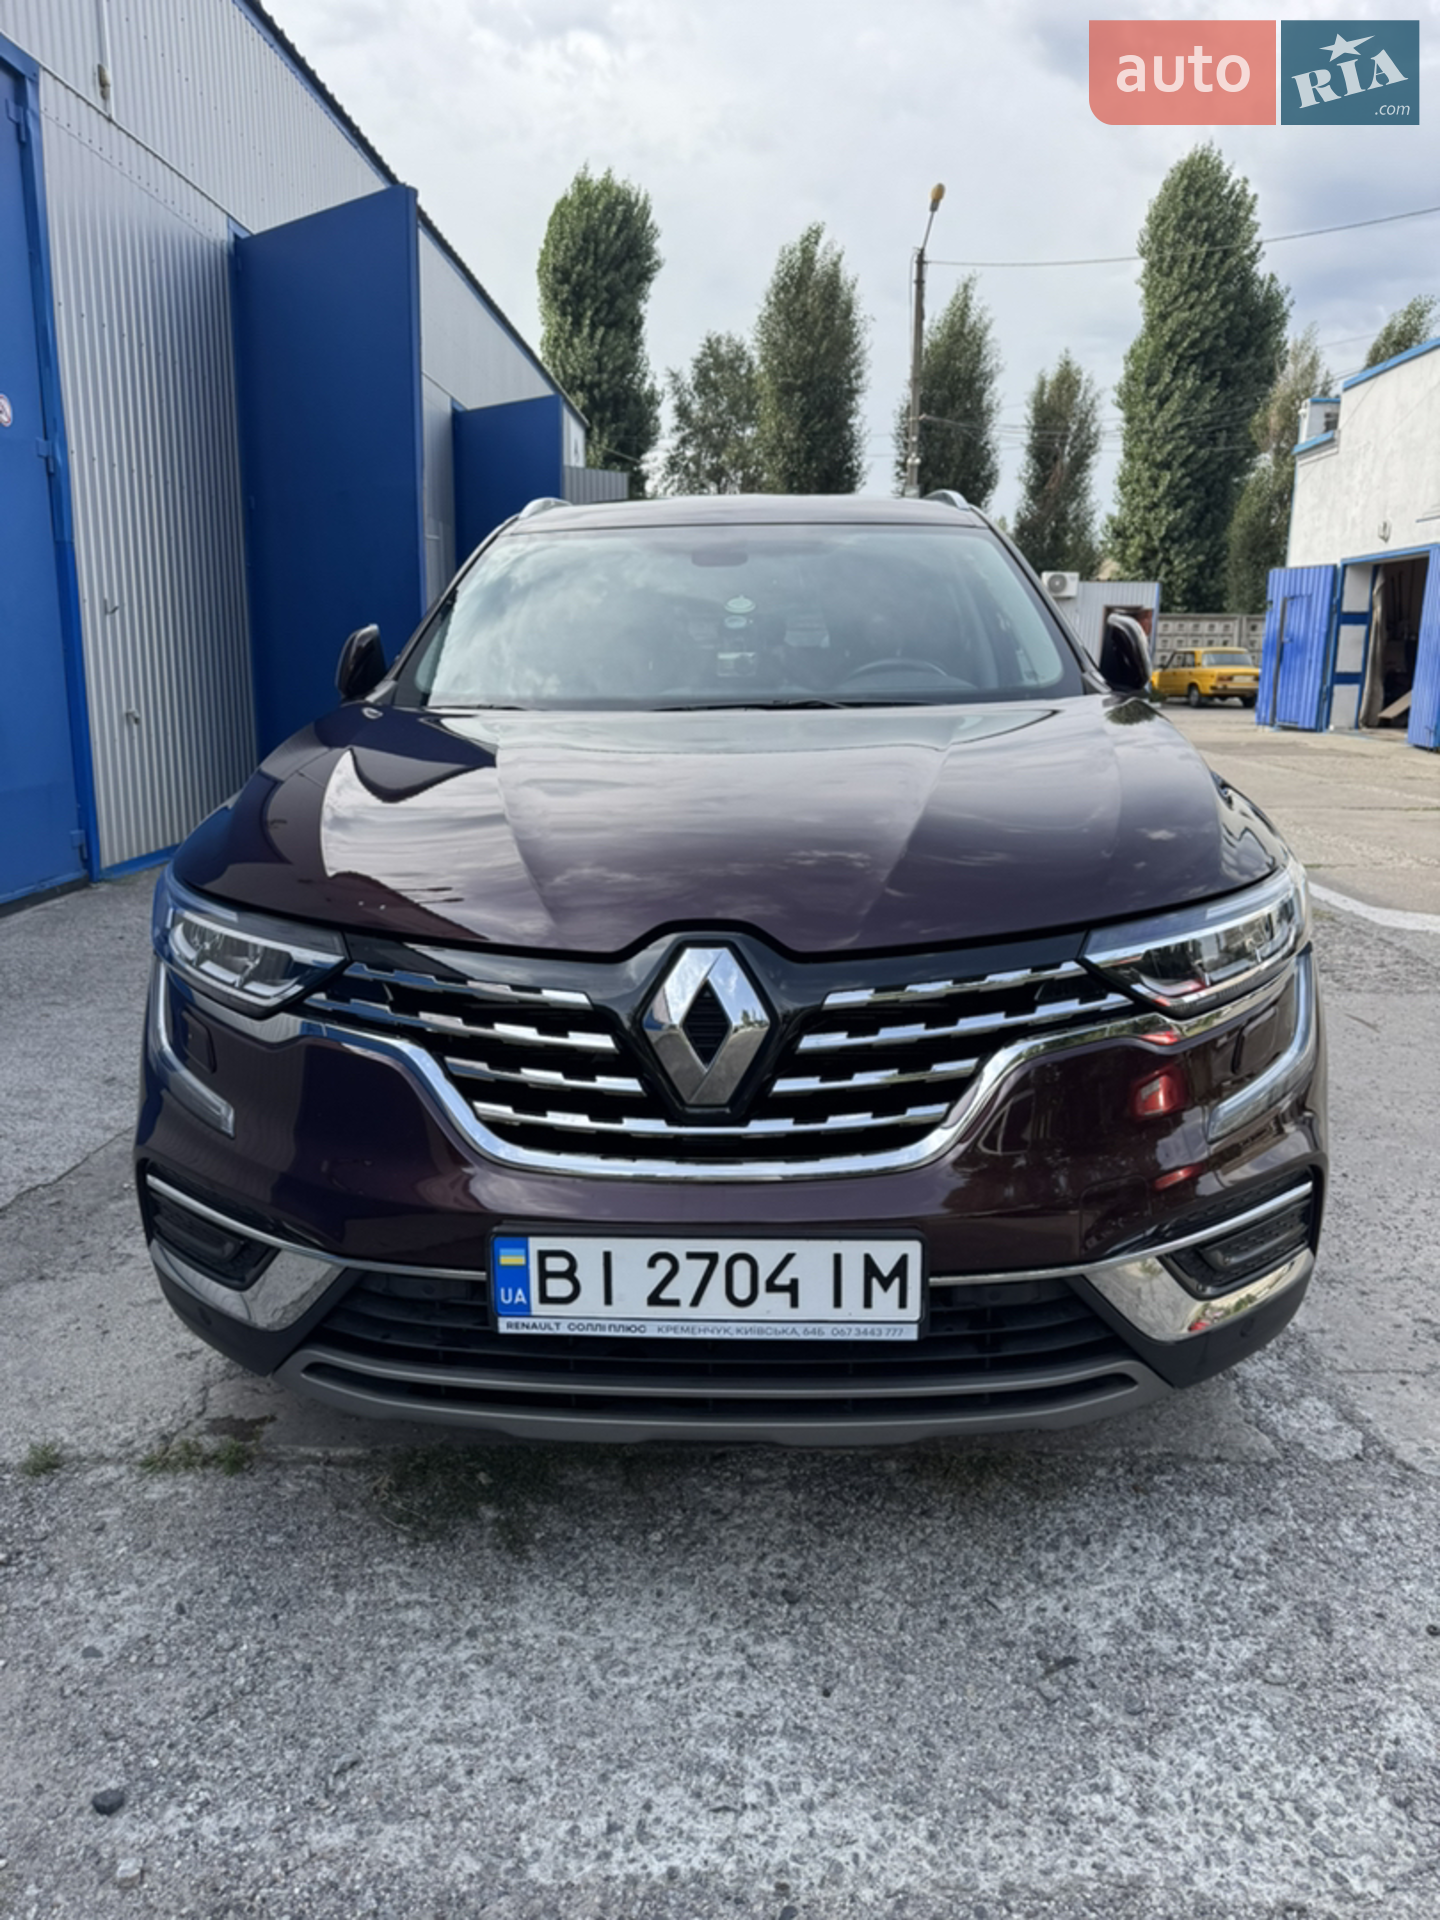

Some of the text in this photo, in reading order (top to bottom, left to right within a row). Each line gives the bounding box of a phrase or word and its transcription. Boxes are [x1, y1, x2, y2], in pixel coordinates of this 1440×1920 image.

[537, 1249, 909, 1309] BI 2704 IM
[500, 1287, 527, 1305] UA
[505, 1320, 561, 1332] RENAULT
